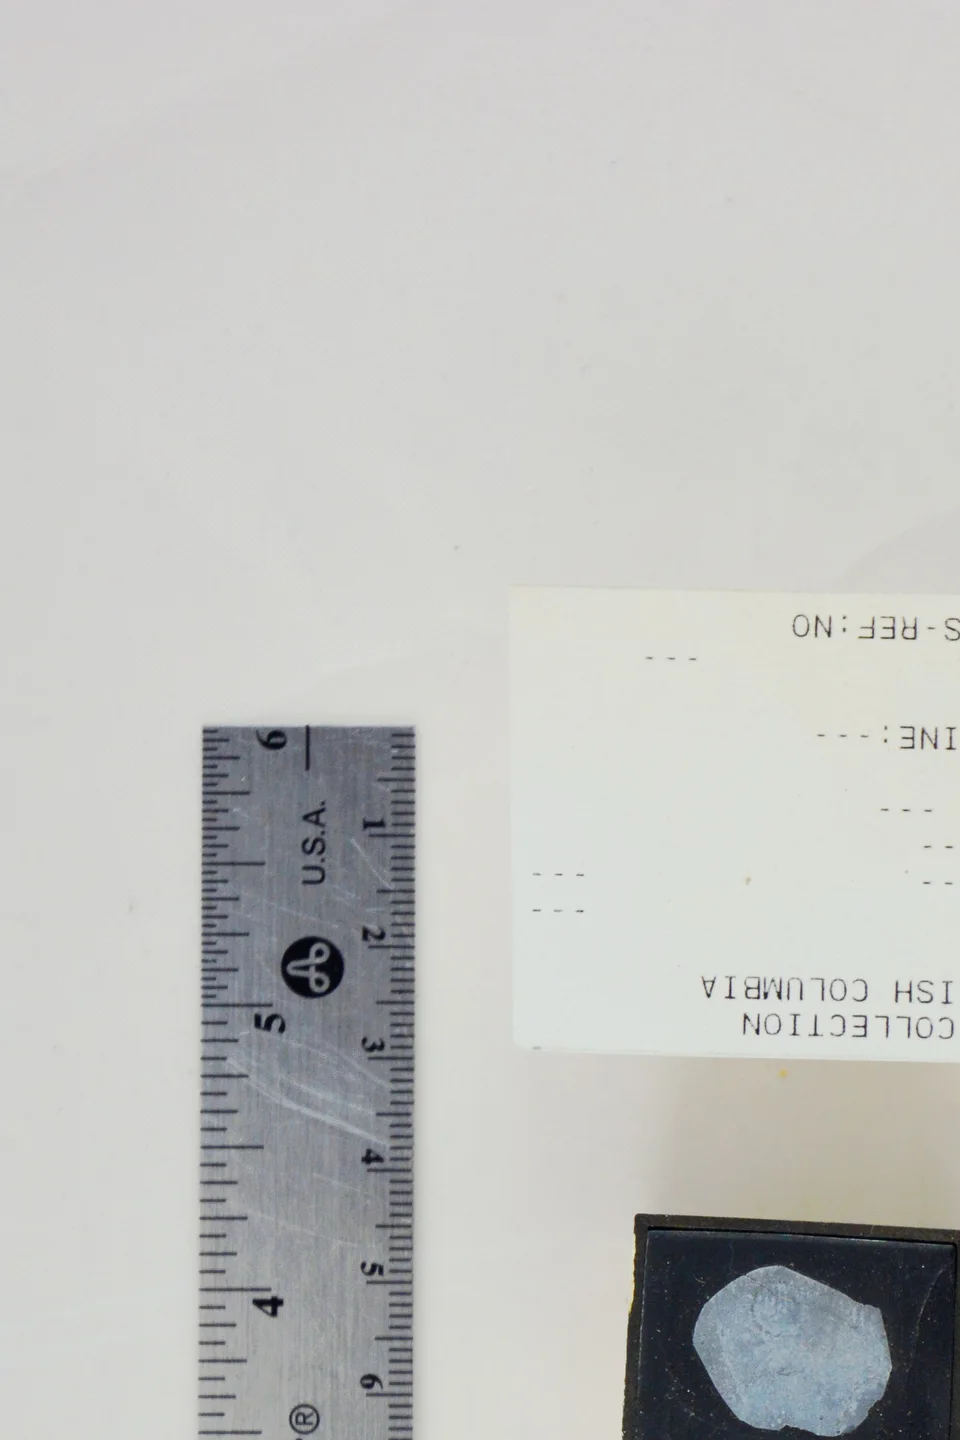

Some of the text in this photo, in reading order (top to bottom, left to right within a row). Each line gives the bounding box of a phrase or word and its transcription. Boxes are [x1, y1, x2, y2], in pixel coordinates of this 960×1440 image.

[257, 729, 287, 751] 6
[362, 817, 386, 831] 1
[301, 800, 327, 886] U.S.A.
[362, 925, 386, 942] 2
[700, 975, 869, 1003] COLUMBIA
[254, 1012, 286, 1034] 5
[742, 1012, 955, 1041] COLLECTION
[361, 1036, 386, 1053] 3
[361, 1148, 385, 1165] 4
[360, 1261, 384, 1277] 5
[252, 1295, 284, 1317] 4
[360, 1373, 384, 1390] 6
